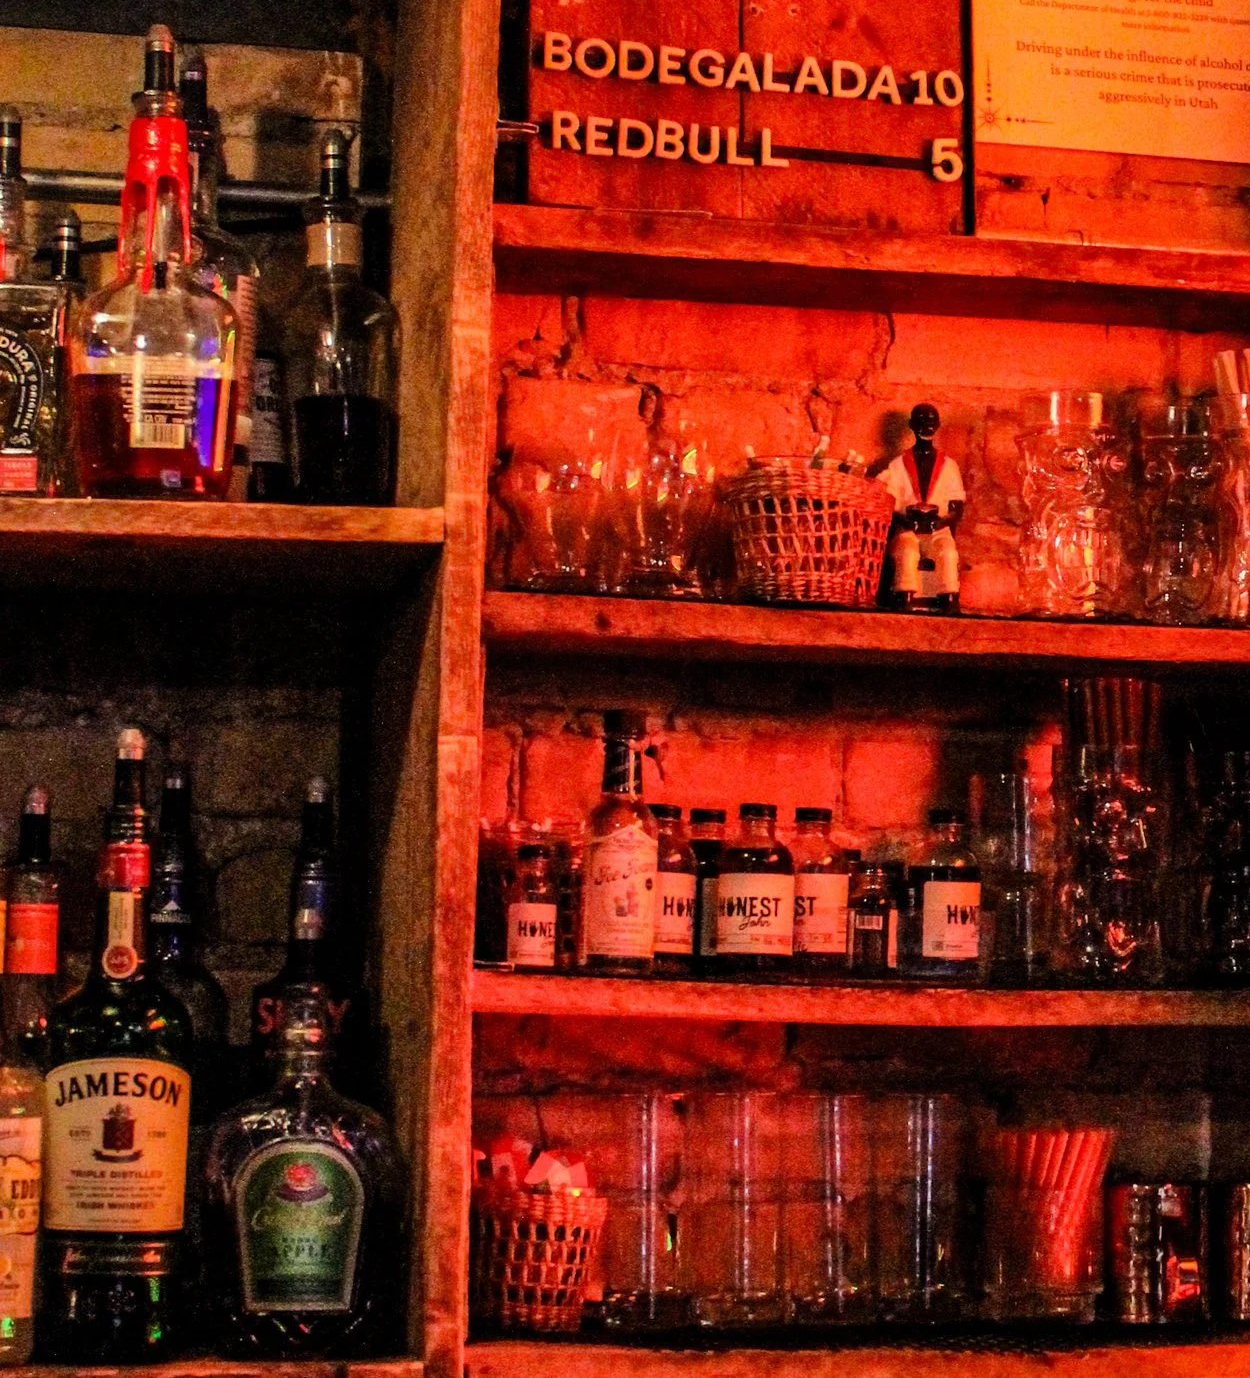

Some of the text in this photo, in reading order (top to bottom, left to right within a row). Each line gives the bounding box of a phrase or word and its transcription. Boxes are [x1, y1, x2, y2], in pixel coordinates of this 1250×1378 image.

[1037, 0, 1050, 8] the
[1051, 0, 1098, 14] Department
[543, 31, 964, 107] BODEGALADA 10
[1016, 40, 1062, 58] Driving
[1065, 46, 1101, 59] under
[1104, 48, 1124, 60] the
[1127, 50, 1183, 65] influence
[1185, 54, 1198, 66] of
[1200, 57, 1243, 71] alcohol
[1050, 64, 1061, 75] is
[1073, 66, 1117, 80] serious
[1120, 71, 1153, 84] crime
[1157, 73, 1181, 86] that
[1184, 75, 1194, 87] is
[1098, 91, 1218, 110] aggressively in Utah
[551, 110, 963, 183] REDBULL 5
[56, 1072, 181, 1107] JAMESON
